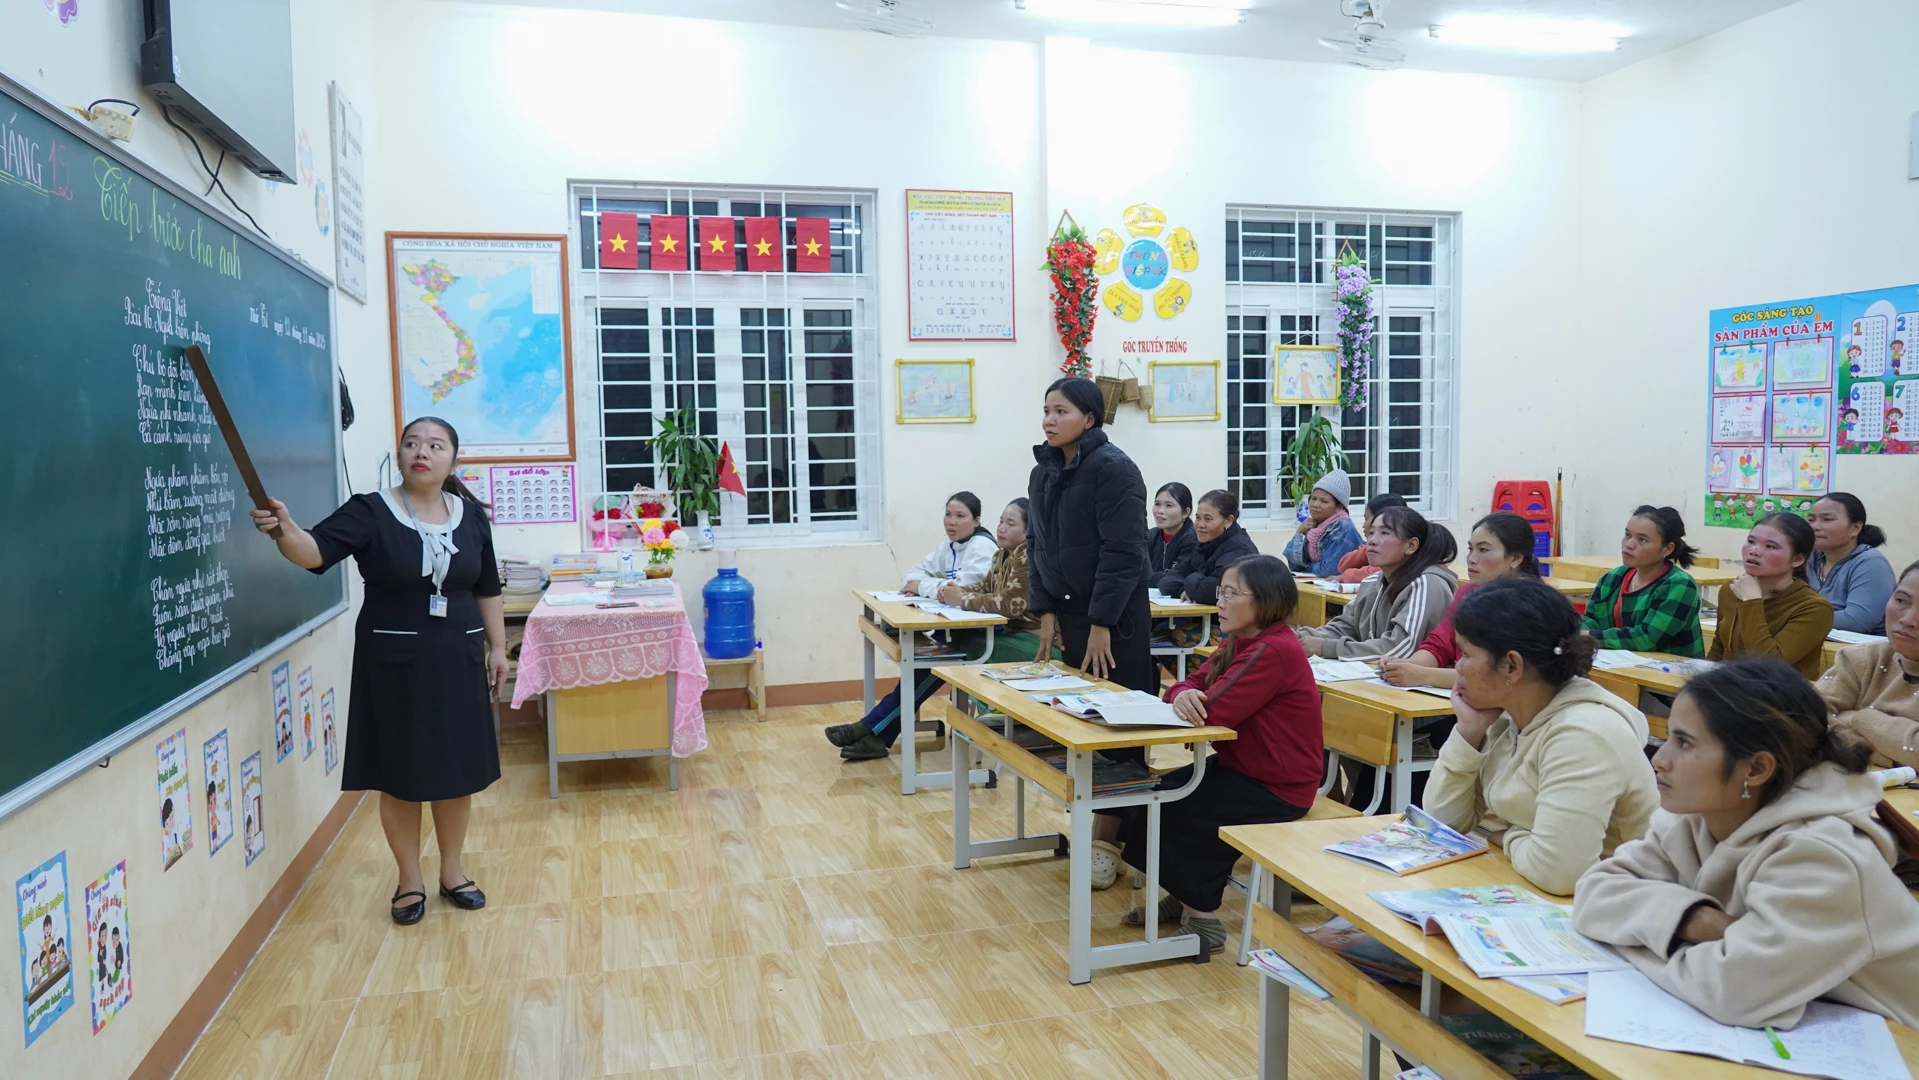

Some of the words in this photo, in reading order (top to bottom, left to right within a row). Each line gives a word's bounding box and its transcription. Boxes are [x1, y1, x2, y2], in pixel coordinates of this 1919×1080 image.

[93, 156, 142, 241] Tiếp
[153, 188, 184, 253] bước
[190, 219, 214, 269] cha
[219, 234, 242, 280] anh
[402, 240, 425, 248] CỘNG
[426, 240, 443, 248] HÒA
[473, 239, 489, 248] CHỦ
[490, 240, 515, 249] NGHĨA
[517, 241, 534, 249] VIỆT
[145, 278, 172, 325] Tiếng
[124, 296, 142, 326] Bài
[191, 320, 211, 354] phòng
[1732, 310, 1755, 323] GÓC
[1756, 308, 1787, 321] SÁNG
[1790, 305, 1814, 318] TẠO
[1896, 316, 1906, 332] 2
[1715, 327, 1740, 342] SẢN
[1743, 322, 1778, 340] PHẨM
[1782, 321, 1809, 336] CỦA
[1814, 320, 1834, 333] EM
[1853, 321, 1862, 336] 1
[1122, 336, 1136, 353] GÓC
[1138, 335, 1164, 353] TRUYỀN
[1165, 335, 1188, 353] THỐNG
[132, 343, 154, 375] Chú
[155, 378, 176, 399] mình
[1851, 386, 1860, 401] 6
[1895, 385, 1906, 399] 7
[160, 399, 171, 429] phi
[168, 464, 188, 494] phăm
[146, 490, 162, 512] Như
[186, 614, 200, 634] như
[22, 885, 36, 903] Chúng
[37, 875, 48, 891] mình
[91, 887, 102, 903] Chúng
[102, 879, 111, 892] mình
[21, 906, 35, 932] Biết
